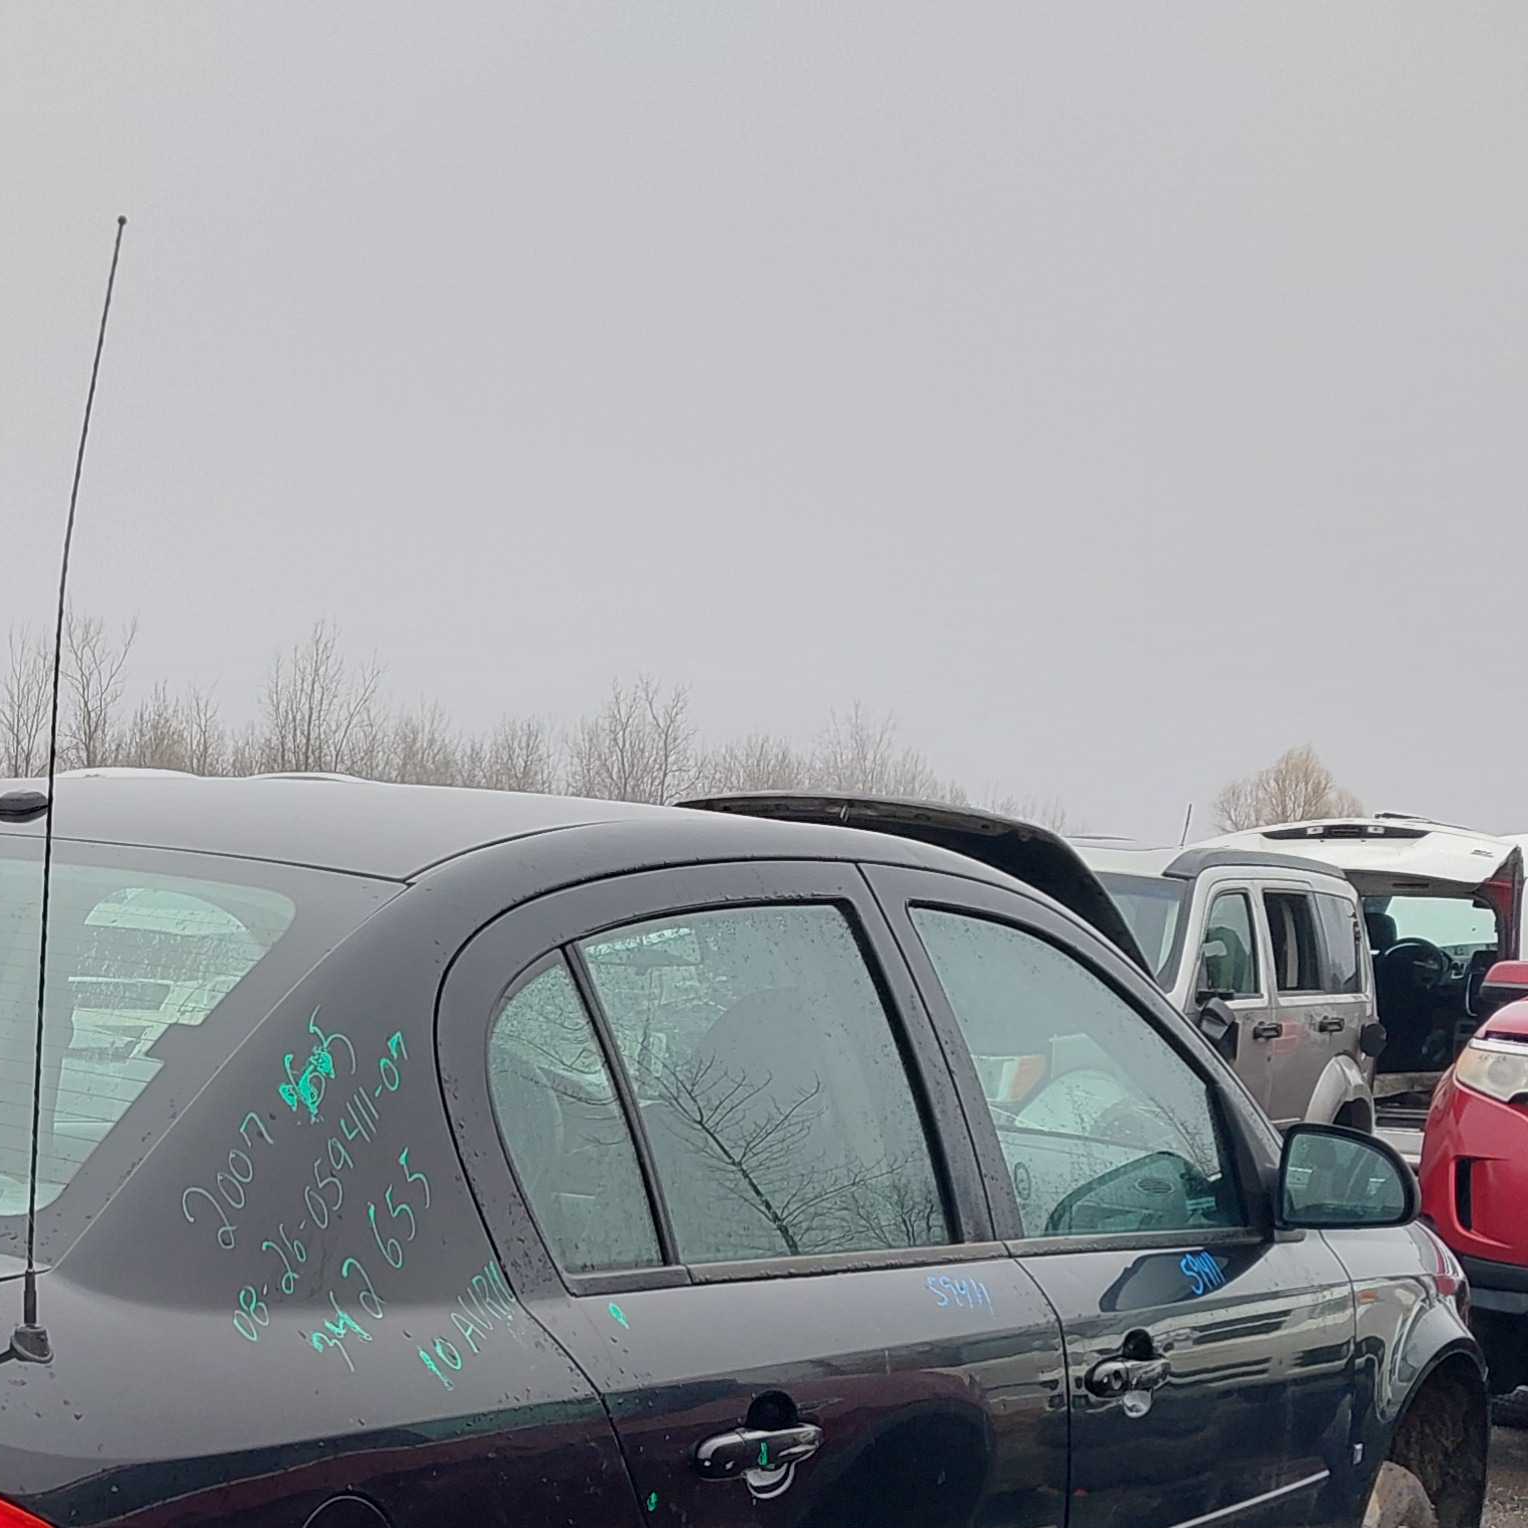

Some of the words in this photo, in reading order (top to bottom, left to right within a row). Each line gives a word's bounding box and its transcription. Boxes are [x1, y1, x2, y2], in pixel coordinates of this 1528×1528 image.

[181, 1111, 274, 1249] 2007
[1180, 1250, 1228, 1296] 59411
[926, 1274, 997, 1321] 59411
